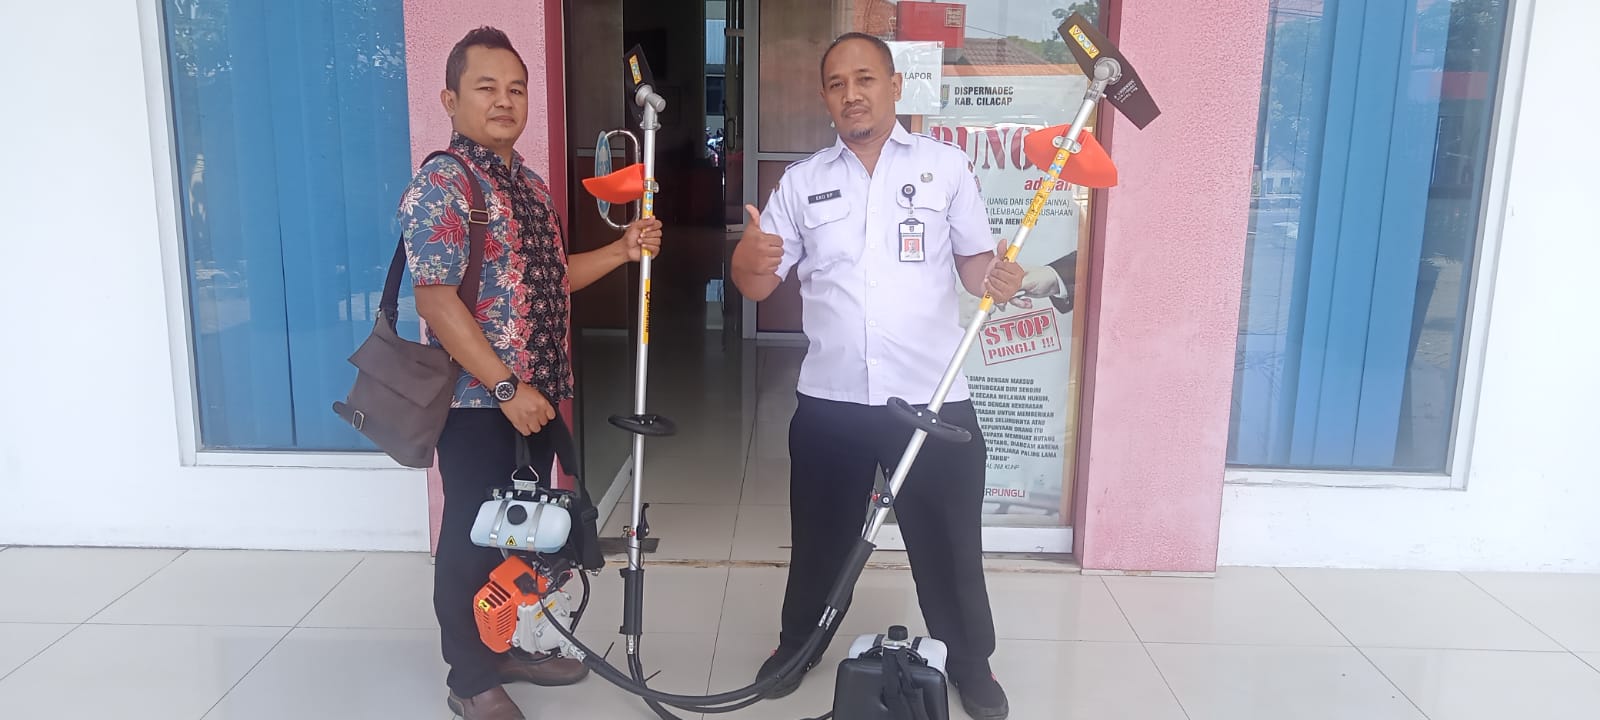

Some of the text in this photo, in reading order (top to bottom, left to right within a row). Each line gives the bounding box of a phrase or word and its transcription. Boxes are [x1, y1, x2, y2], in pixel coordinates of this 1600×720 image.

[904, 72, 932, 80] LAPOR
[954, 97, 1013, 106] KAB. CILACAP
[986, 198, 1008, 206] (UANG
[1009, 198, 1024, 206] DAN
[984, 315, 1050, 346] STOP
[988, 336, 1054, 359] PUNGLI !!!
[969, 375, 986, 383] SIAPA
[986, 376, 1009, 384] DENGAN
[1010, 377, 1035, 385] MAKSUD
[1018, 386, 1042, 394] SENDIRI
[975, 392, 997, 400] SECARA
[987, 401, 1010, 409] DENGAN
[1011, 402, 1043, 410] KEKERASAN
[1016, 410, 1055, 418] MEMBERIKAN
[1013, 426, 1033, 434] ORANG
[982, 431, 1004, 439] SUPAYA
[1004, 432, 1033, 440] MEMBUAT
[1010, 440, 1037, 449] DIANCAM
[994, 447, 1020, 455] PENJARA
[1020, 449, 1040, 457] PALING
[1040, 451, 1057, 459] LAMA
